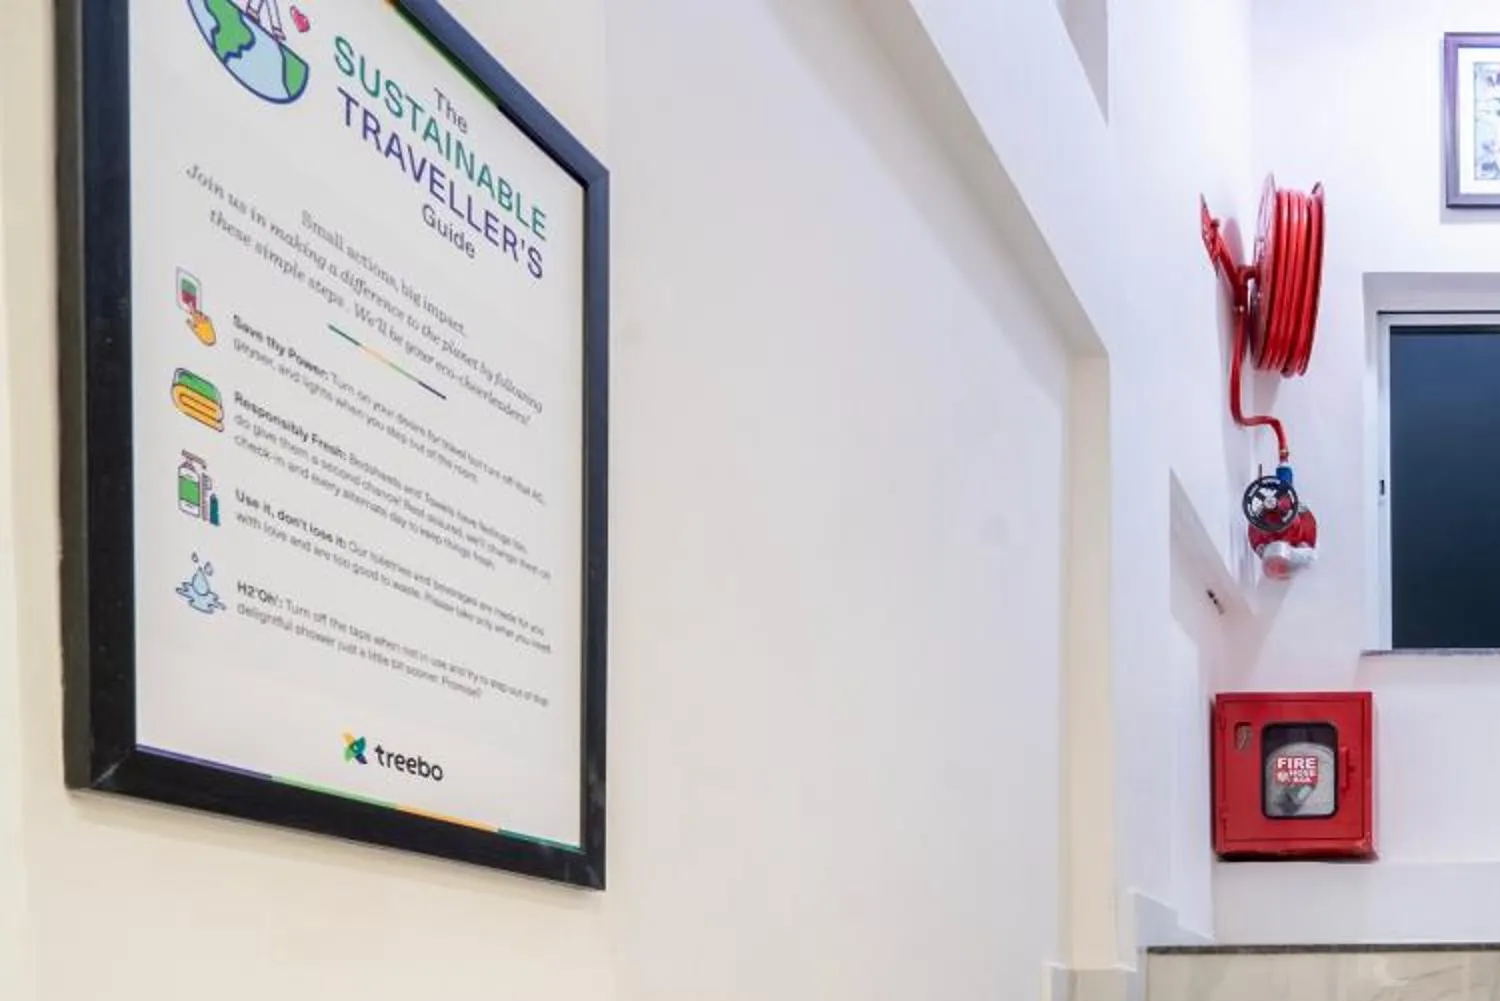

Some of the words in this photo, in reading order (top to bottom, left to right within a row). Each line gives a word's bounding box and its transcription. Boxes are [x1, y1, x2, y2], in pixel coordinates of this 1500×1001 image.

[334, 36, 546, 241] SUSTAINABLE
[434, 87, 468, 134] The
[337, 86, 543, 279] TRAVELLER'S
[186, 164, 224, 200] Join
[228, 193, 247, 215] us
[251, 207, 266, 228] in
[270, 222, 327, 270] making
[328, 263, 338, 277] a
[341, 270, 405, 321] difference
[301, 210, 345, 253] Small
[347, 246, 399, 293] actions,
[422, 203, 475, 259] Guide
[210, 209, 251, 247] these
[255, 242, 306, 281] simple
[354, 302, 387, 337] We'll
[389, 325, 403, 346] be
[374, 744, 444, 781] treebo
[1277, 757, 1317, 769] FIRE
